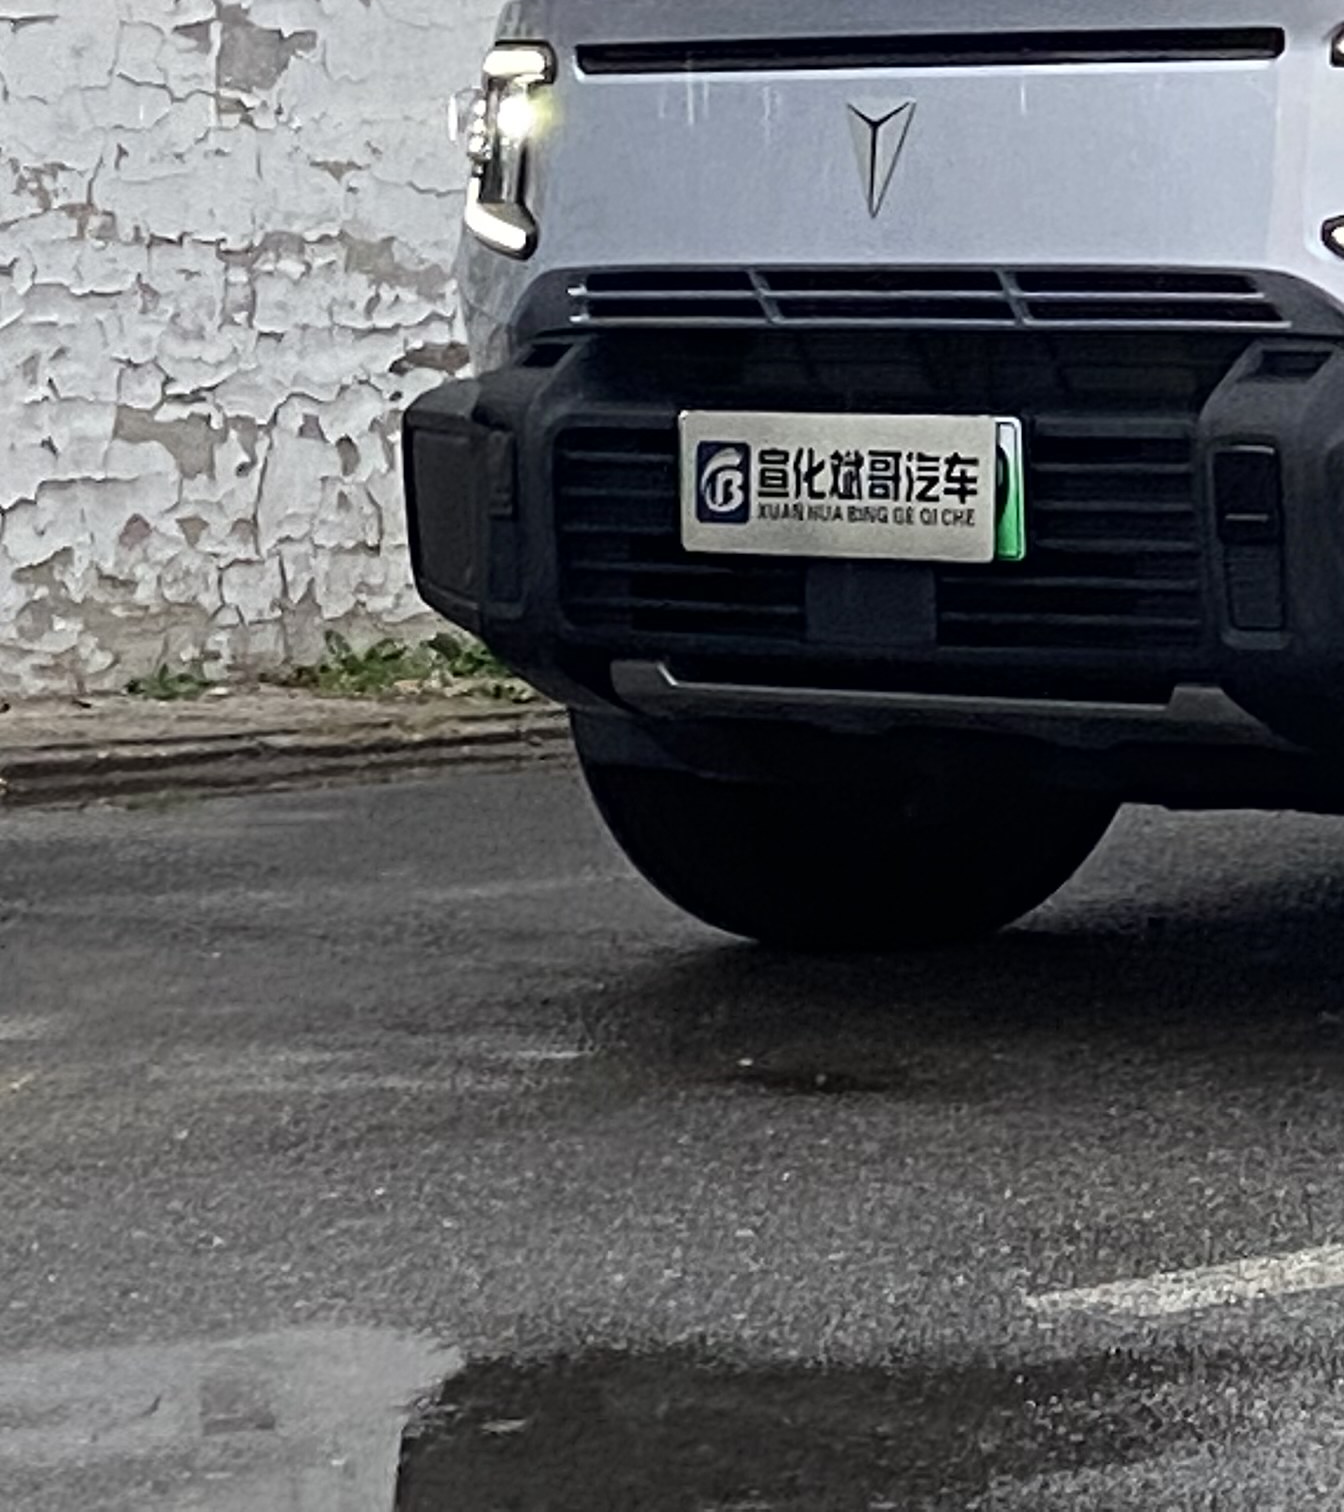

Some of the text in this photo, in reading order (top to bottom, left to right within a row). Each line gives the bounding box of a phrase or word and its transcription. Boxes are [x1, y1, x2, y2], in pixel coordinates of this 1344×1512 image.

[758, 448, 979, 504] 宣化斌哥汽车
[758, 503, 804, 521] XUAN
[807, 504, 843, 522] HUA
[847, 505, 889, 524] BING
[941, 508, 976, 527] CHE
